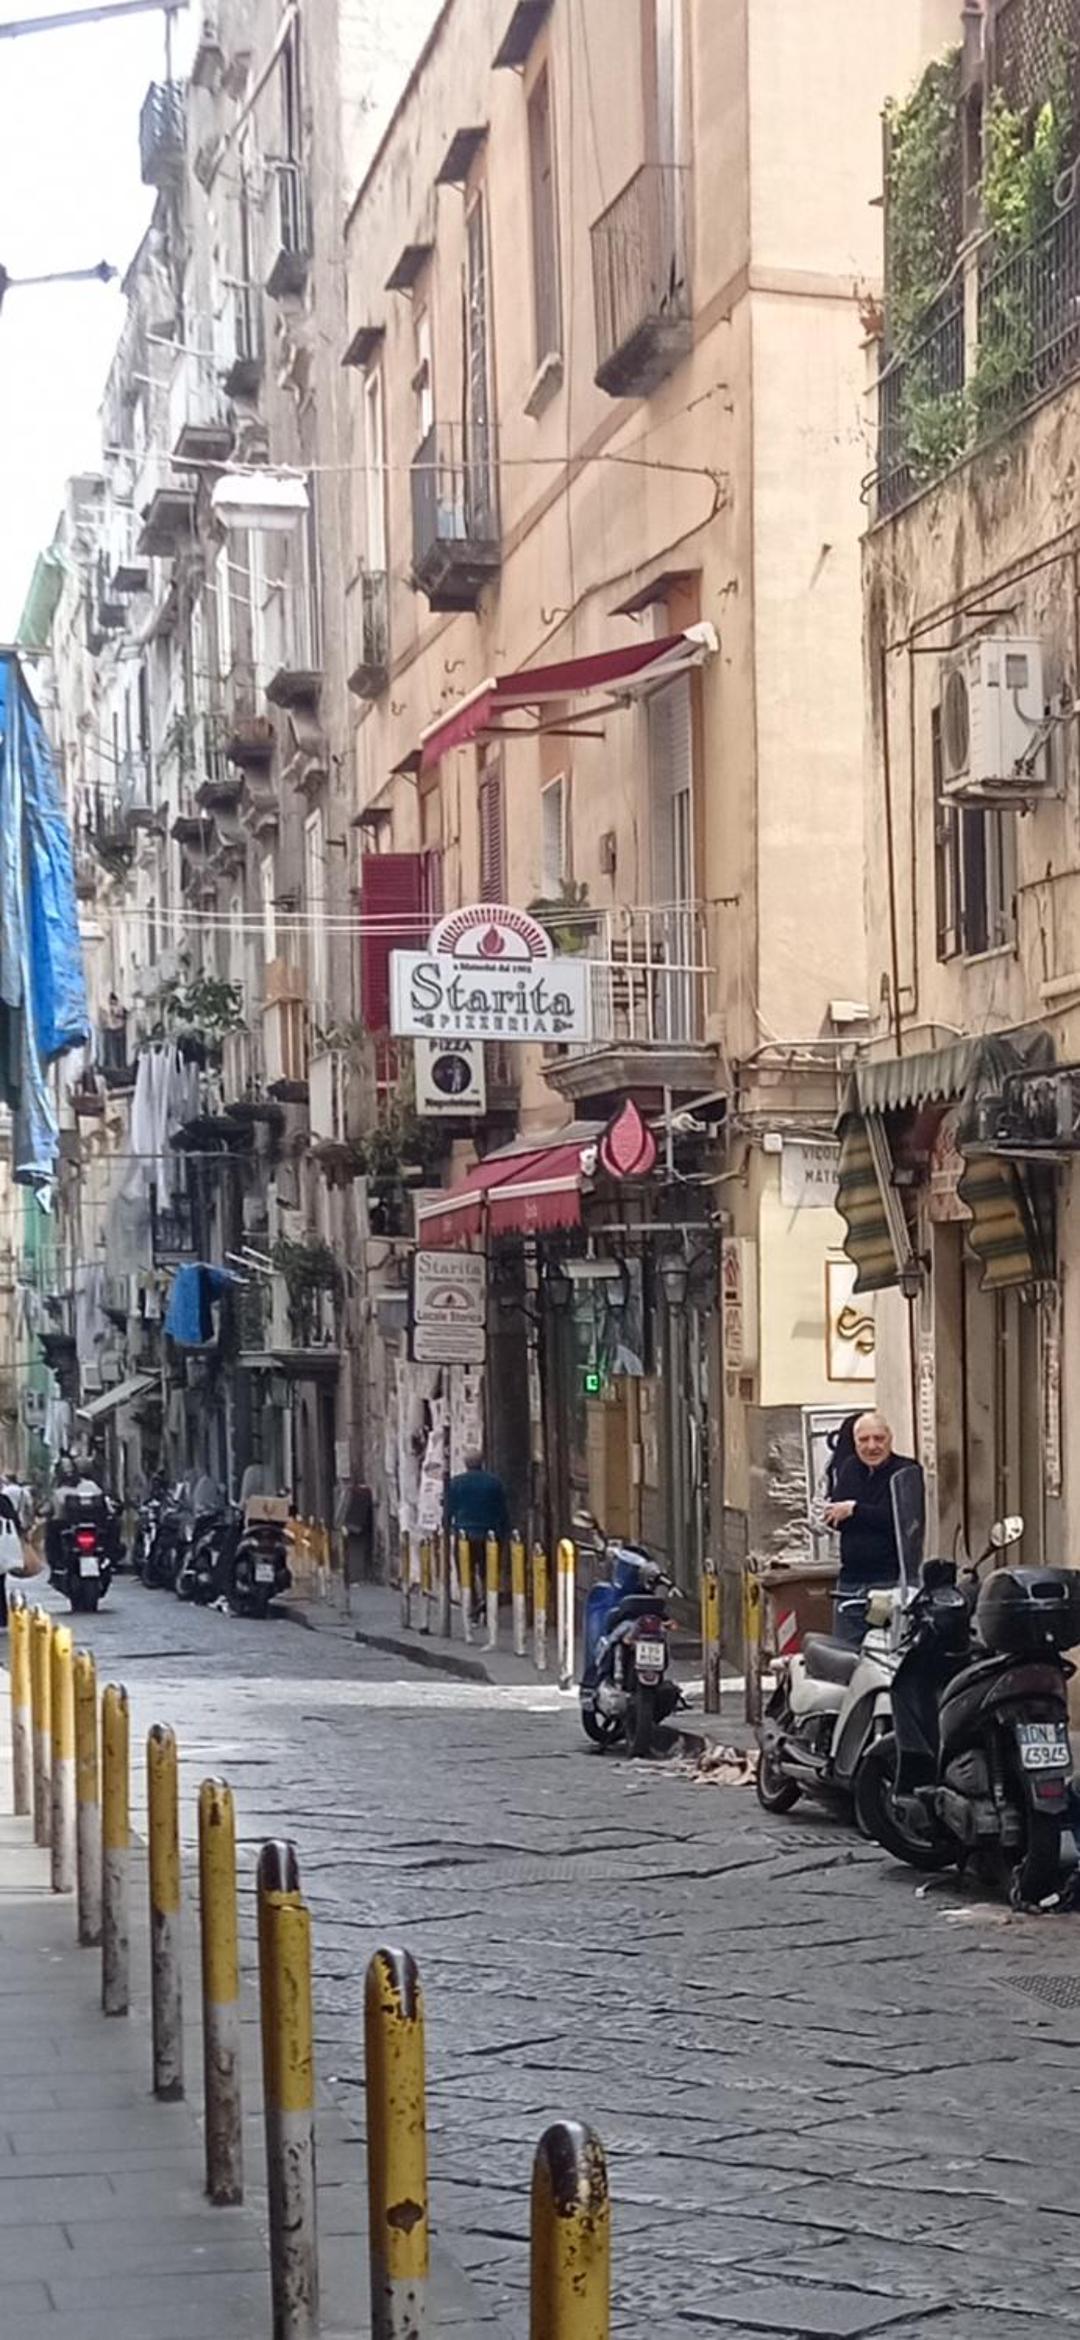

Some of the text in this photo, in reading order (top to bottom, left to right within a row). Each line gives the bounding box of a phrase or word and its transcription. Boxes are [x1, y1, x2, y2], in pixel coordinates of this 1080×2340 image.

[410, 963, 575, 1017] Starita
[440, 1014, 547, 1032] PIZZERIA
[428, 1038, 474, 1053] PIZZA
[418, 1254, 483, 1275] Starita
